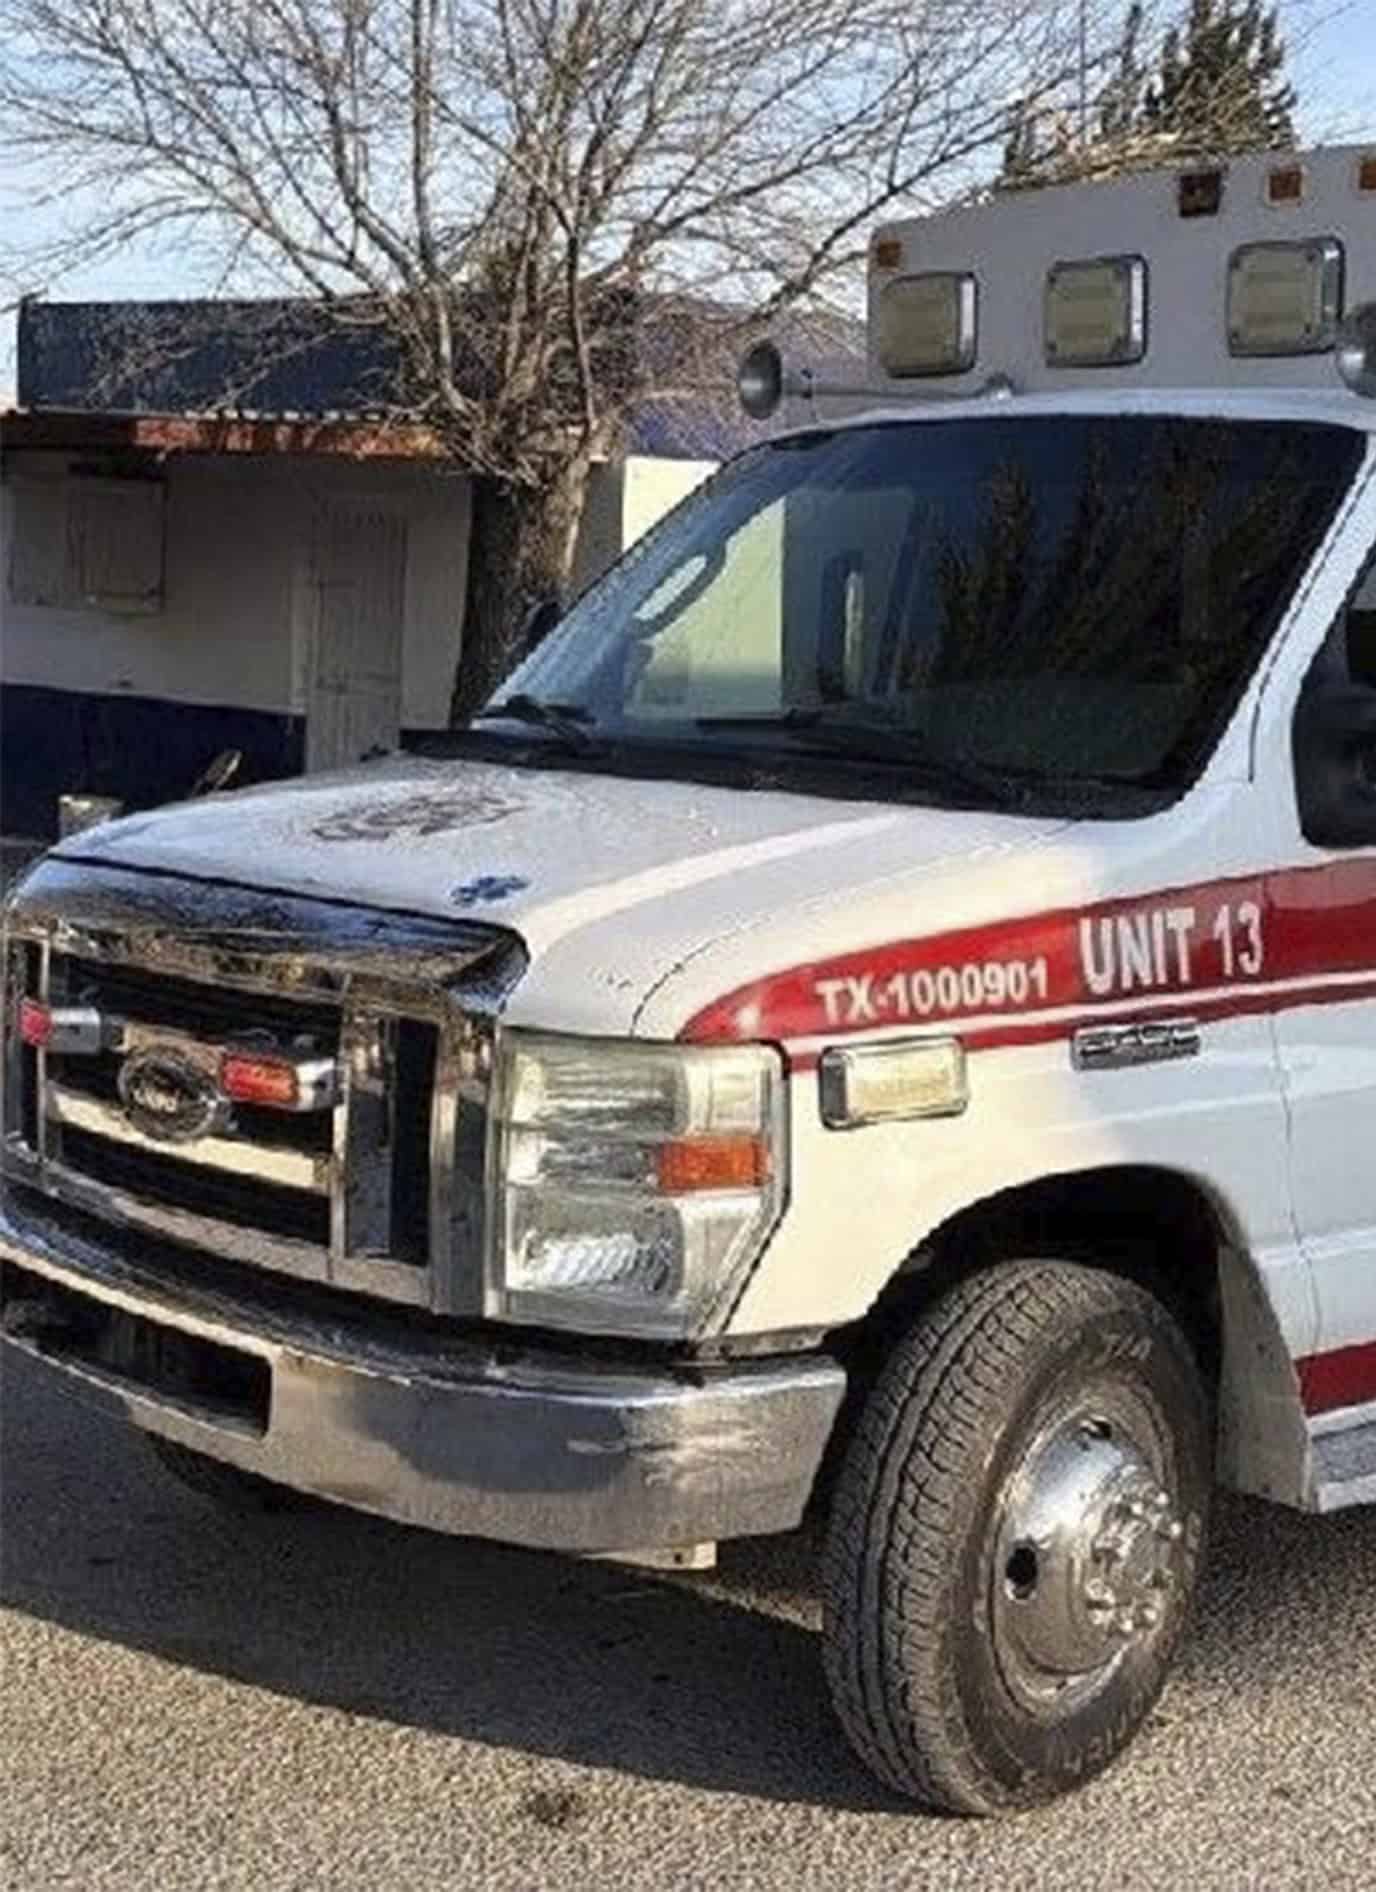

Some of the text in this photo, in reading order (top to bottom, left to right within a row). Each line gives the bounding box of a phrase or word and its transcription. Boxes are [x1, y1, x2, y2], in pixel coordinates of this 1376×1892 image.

[1080, 901, 1264, 995] UNIT 13
[815, 957, 1048, 1025] TX-1000901
